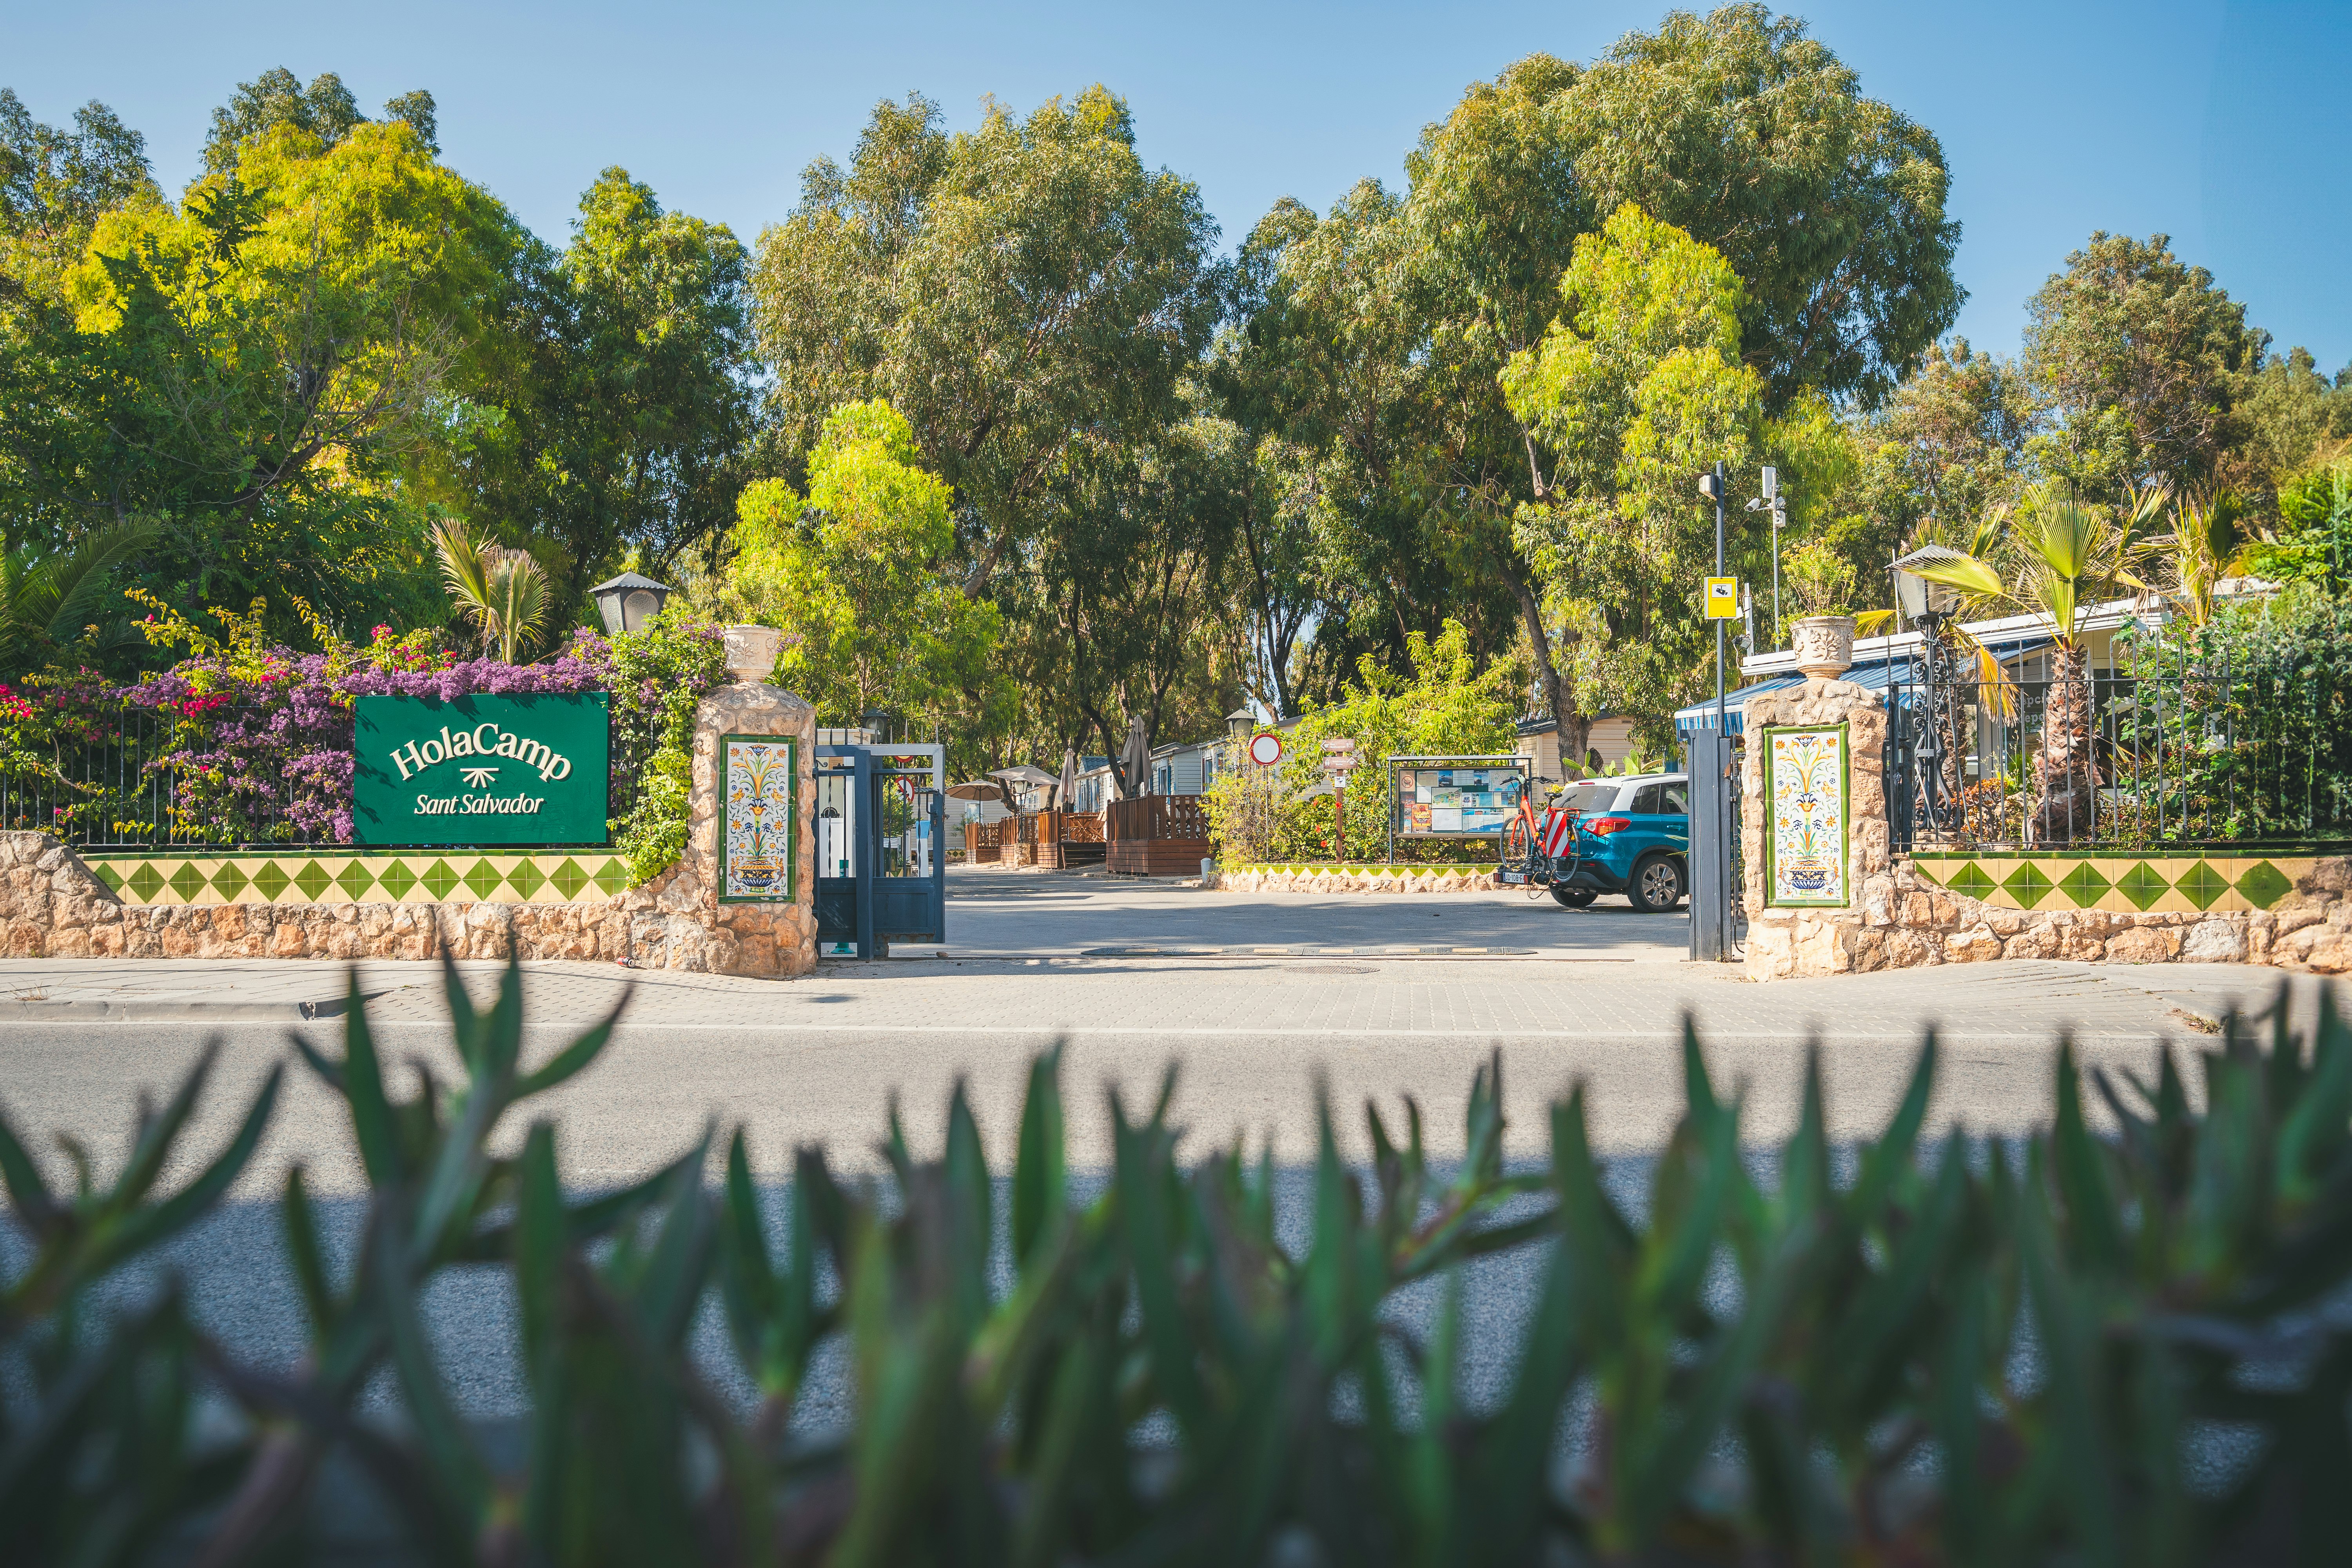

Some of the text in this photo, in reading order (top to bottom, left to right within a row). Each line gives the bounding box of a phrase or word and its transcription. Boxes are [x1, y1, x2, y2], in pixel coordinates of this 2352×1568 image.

[389, 723, 572, 783] HolaCamp
[414, 793, 544, 815] Sant Salvador
